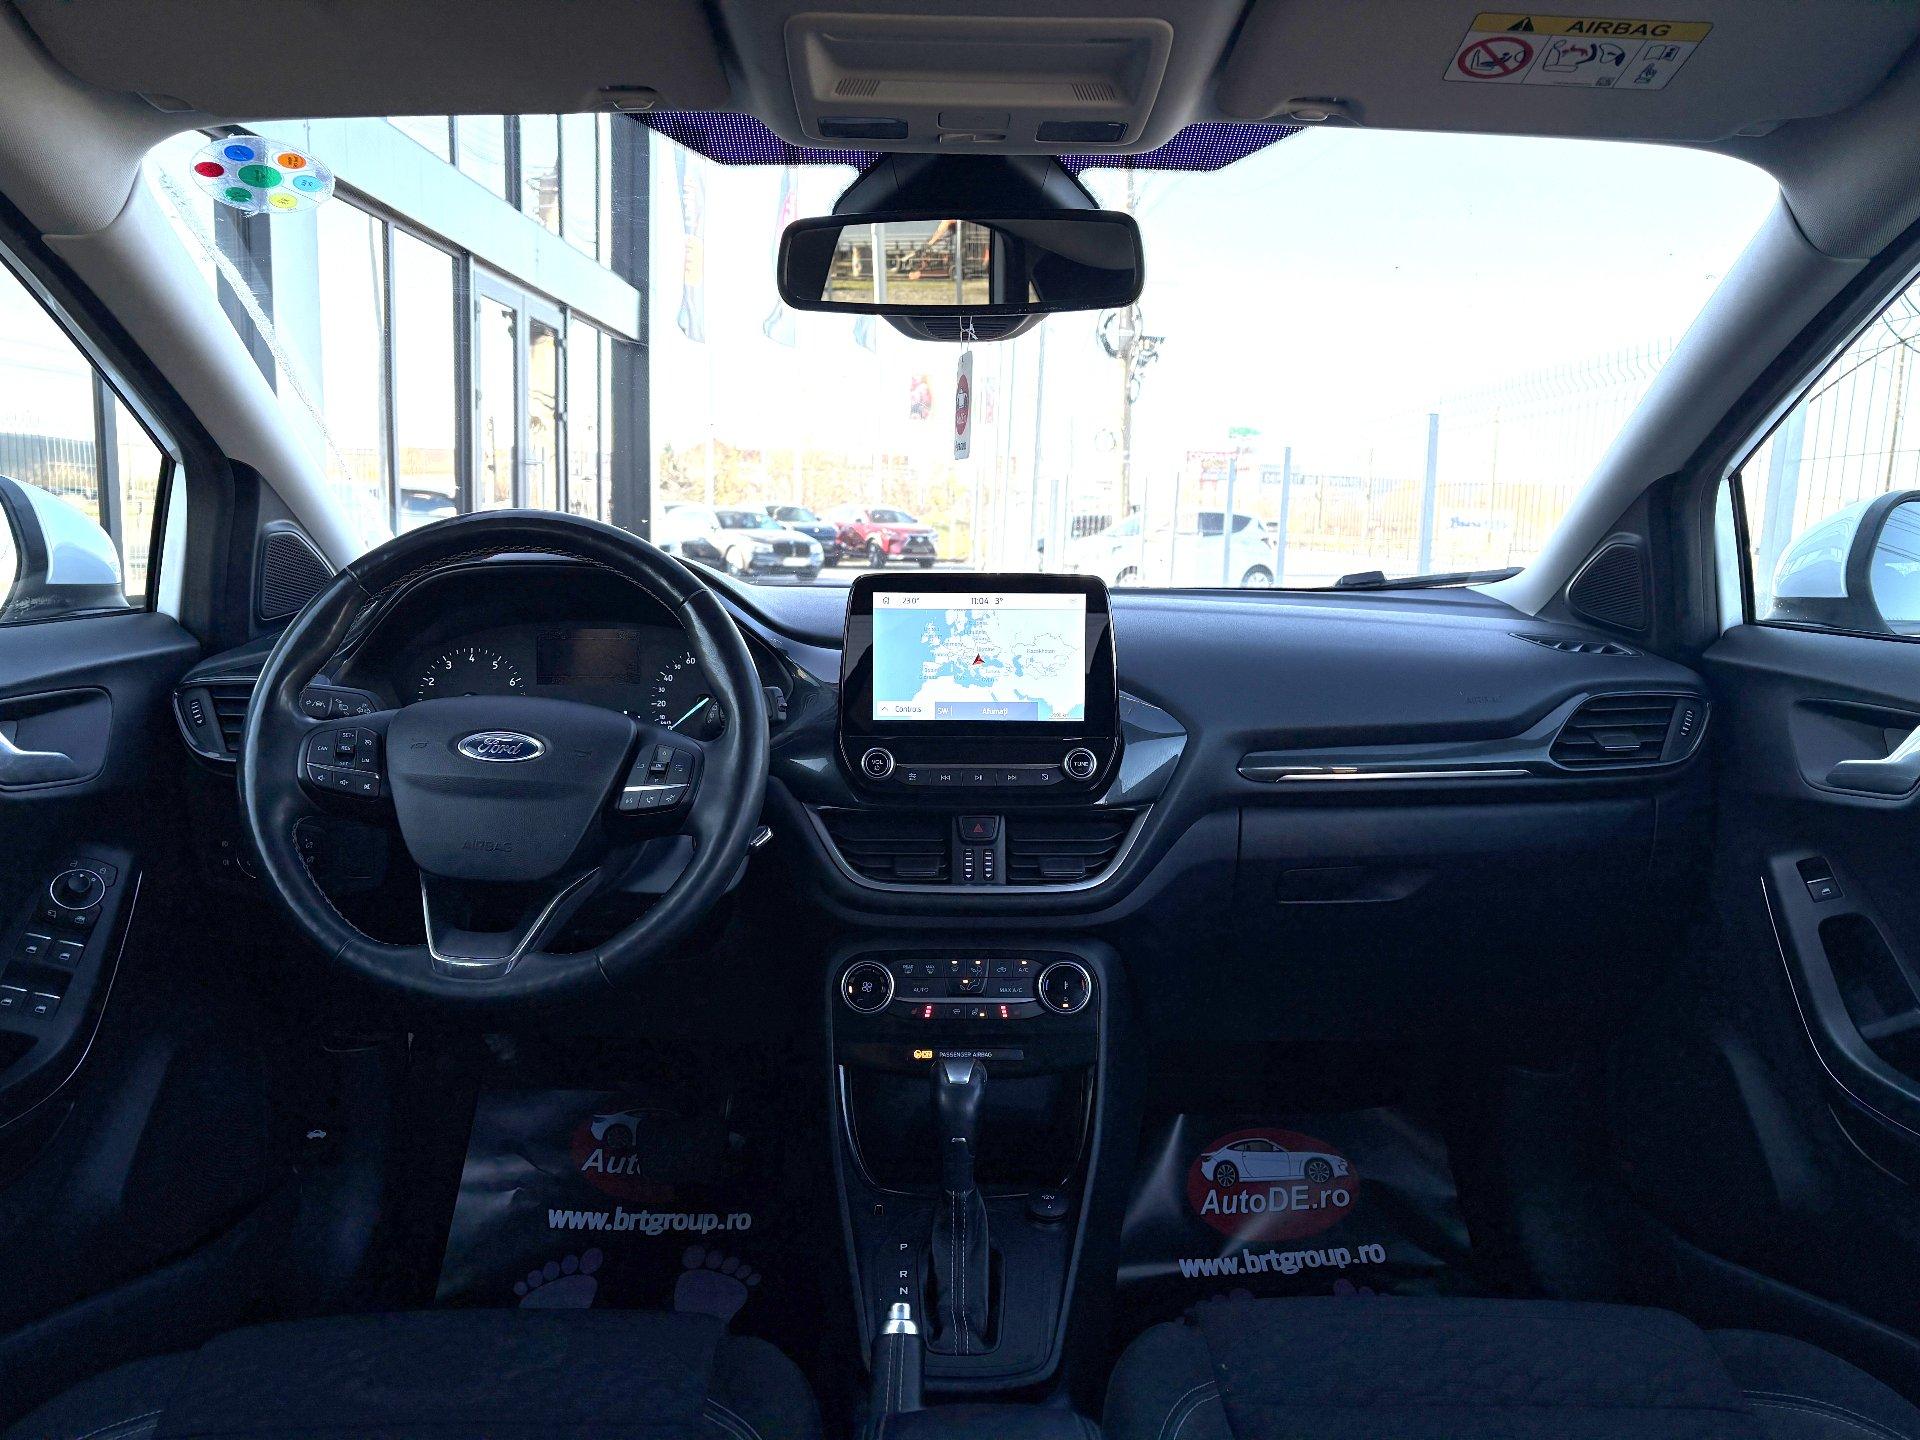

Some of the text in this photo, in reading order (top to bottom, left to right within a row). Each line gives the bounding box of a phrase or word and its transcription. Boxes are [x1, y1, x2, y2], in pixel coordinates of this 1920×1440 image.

[1565, 20, 1672, 37] AIRBAG
[971, 597, 989, 605] 11:04
[469, 654, 475, 662] 4
[445, 661, 452, 669] 3
[492, 661, 498, 670] 5
[428, 678, 435, 686] 2
[509, 678, 516, 686] 6
[895, 705, 922, 713] Controls
[937, 707, 949, 715] SW
[477, 737, 523, 755] Ford
[1200, 1185, 1350, 1216] AutoDE.ro
[548, 1206, 752, 1235] www.brtgroup.ro
[899, 1243, 908, 1251] P
[1178, 1243, 1386, 1278] www.brtgroup.ro
[899, 1270, 908, 1278] R
[899, 1286, 909, 1295] N
